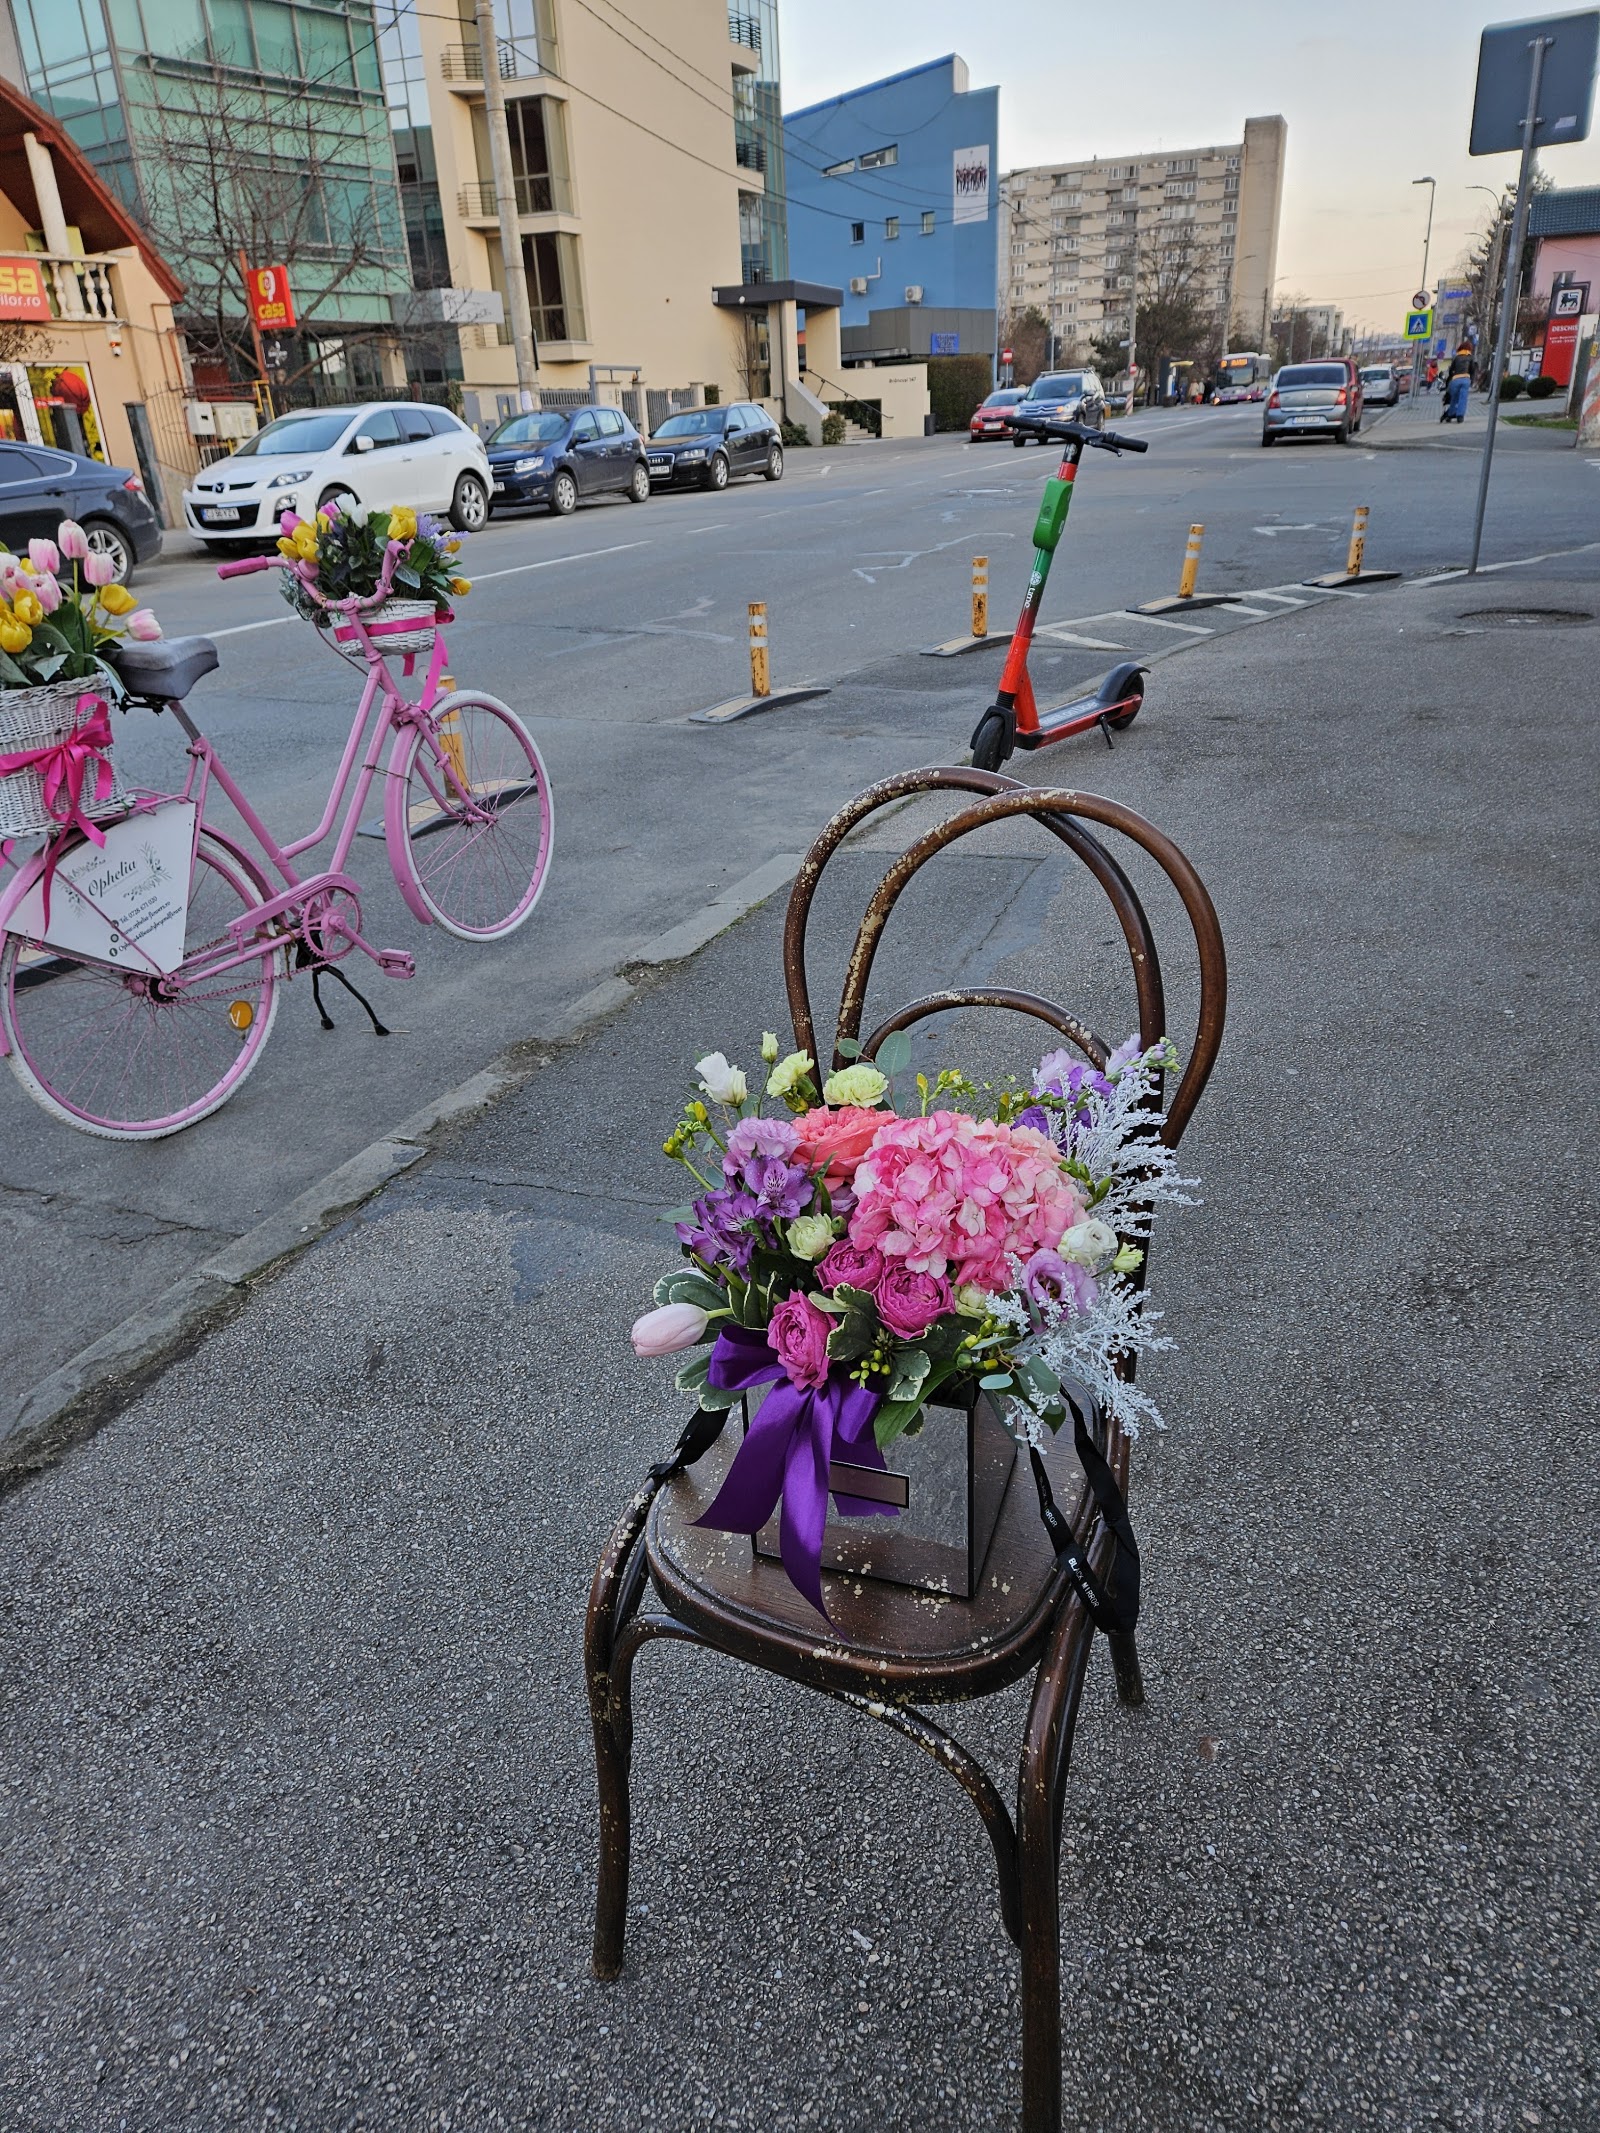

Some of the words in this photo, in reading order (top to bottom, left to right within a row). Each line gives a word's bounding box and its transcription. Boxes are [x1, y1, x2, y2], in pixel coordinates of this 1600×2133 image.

[258, 302, 286, 319] casa
[88, 861, 136, 897] Ophelia
[122, 901, 171, 936] ww.ophelia-flowers.ro
[1068, 1557, 1084, 1581] BLACK
[1081, 1581, 1100, 1608] MIRROR
